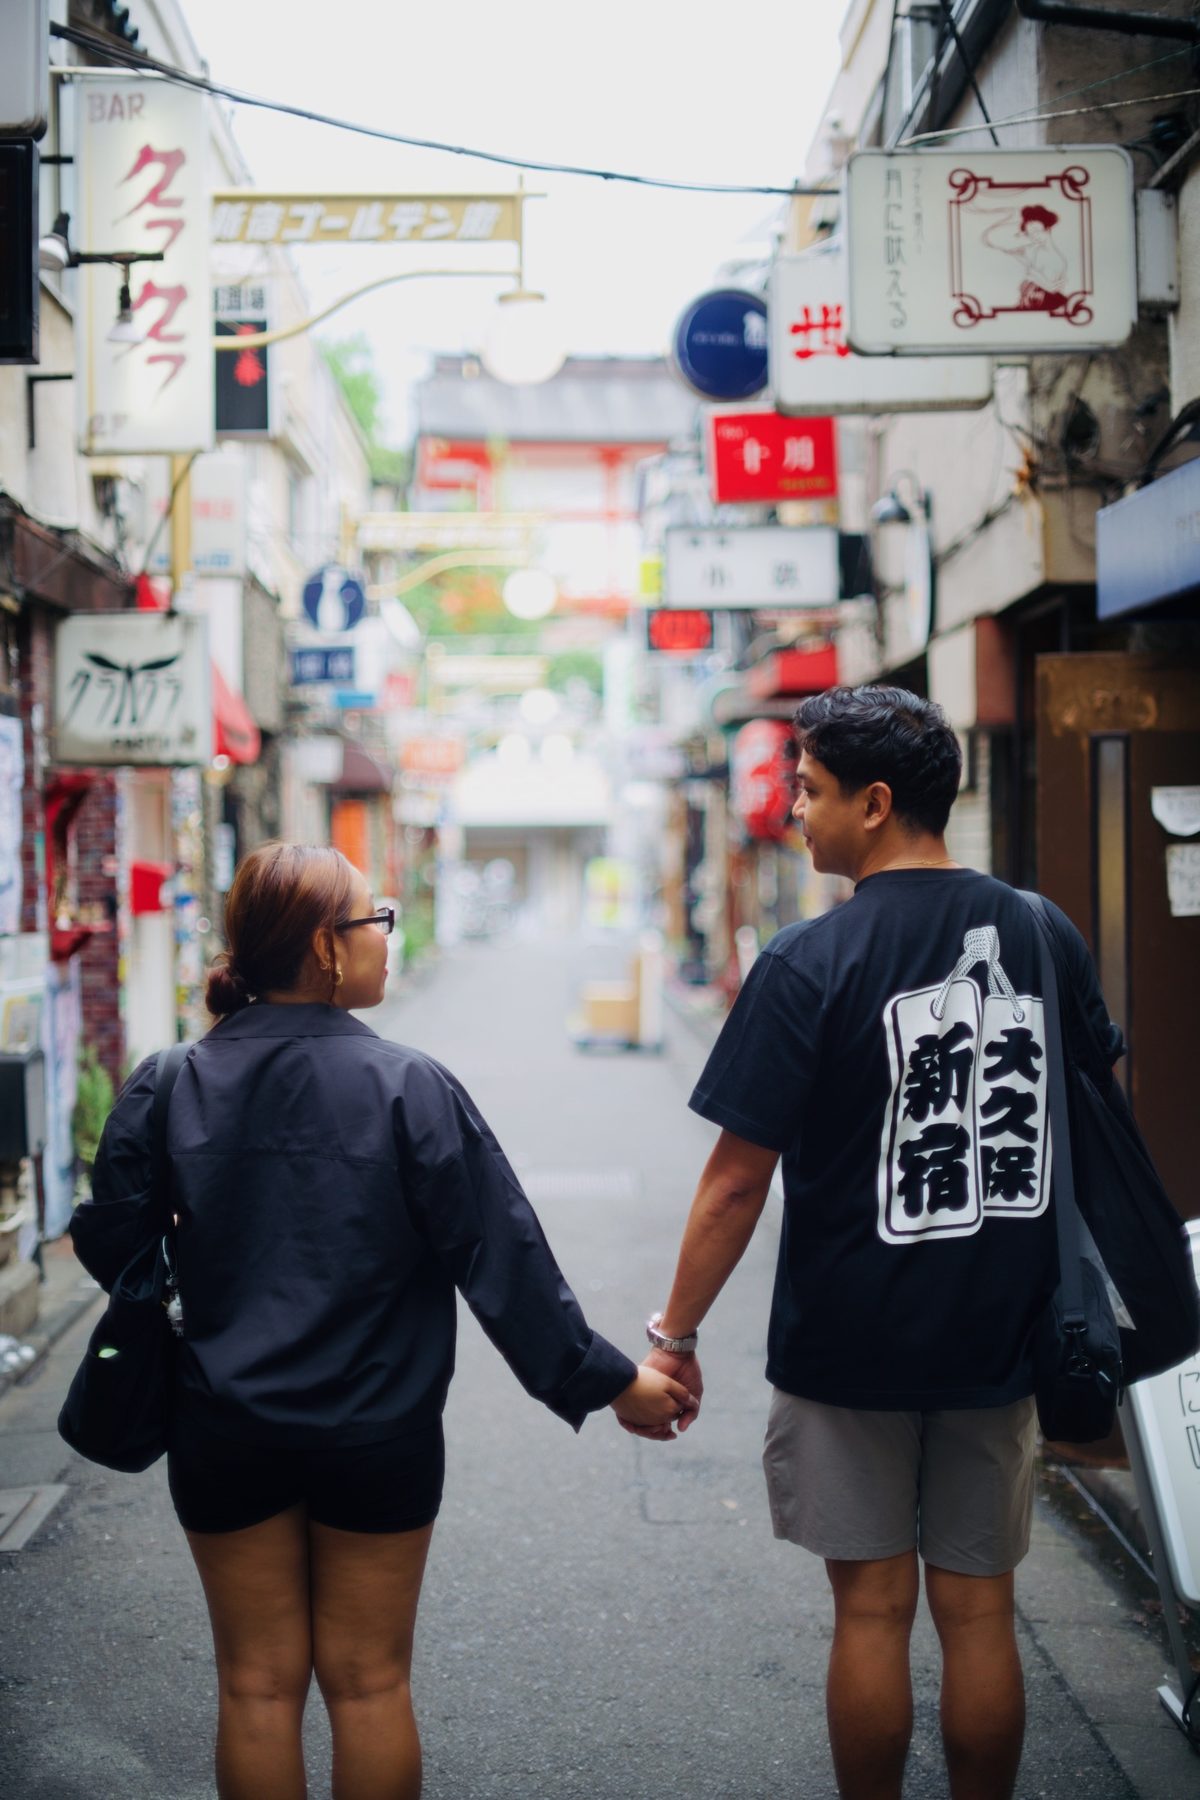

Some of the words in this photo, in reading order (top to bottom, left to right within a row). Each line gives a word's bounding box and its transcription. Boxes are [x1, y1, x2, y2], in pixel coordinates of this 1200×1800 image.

[87, 92, 145, 123] BAR
[896, 1021, 975, 1219] 新宿
[977, 1026, 1044, 1203] 大久保
